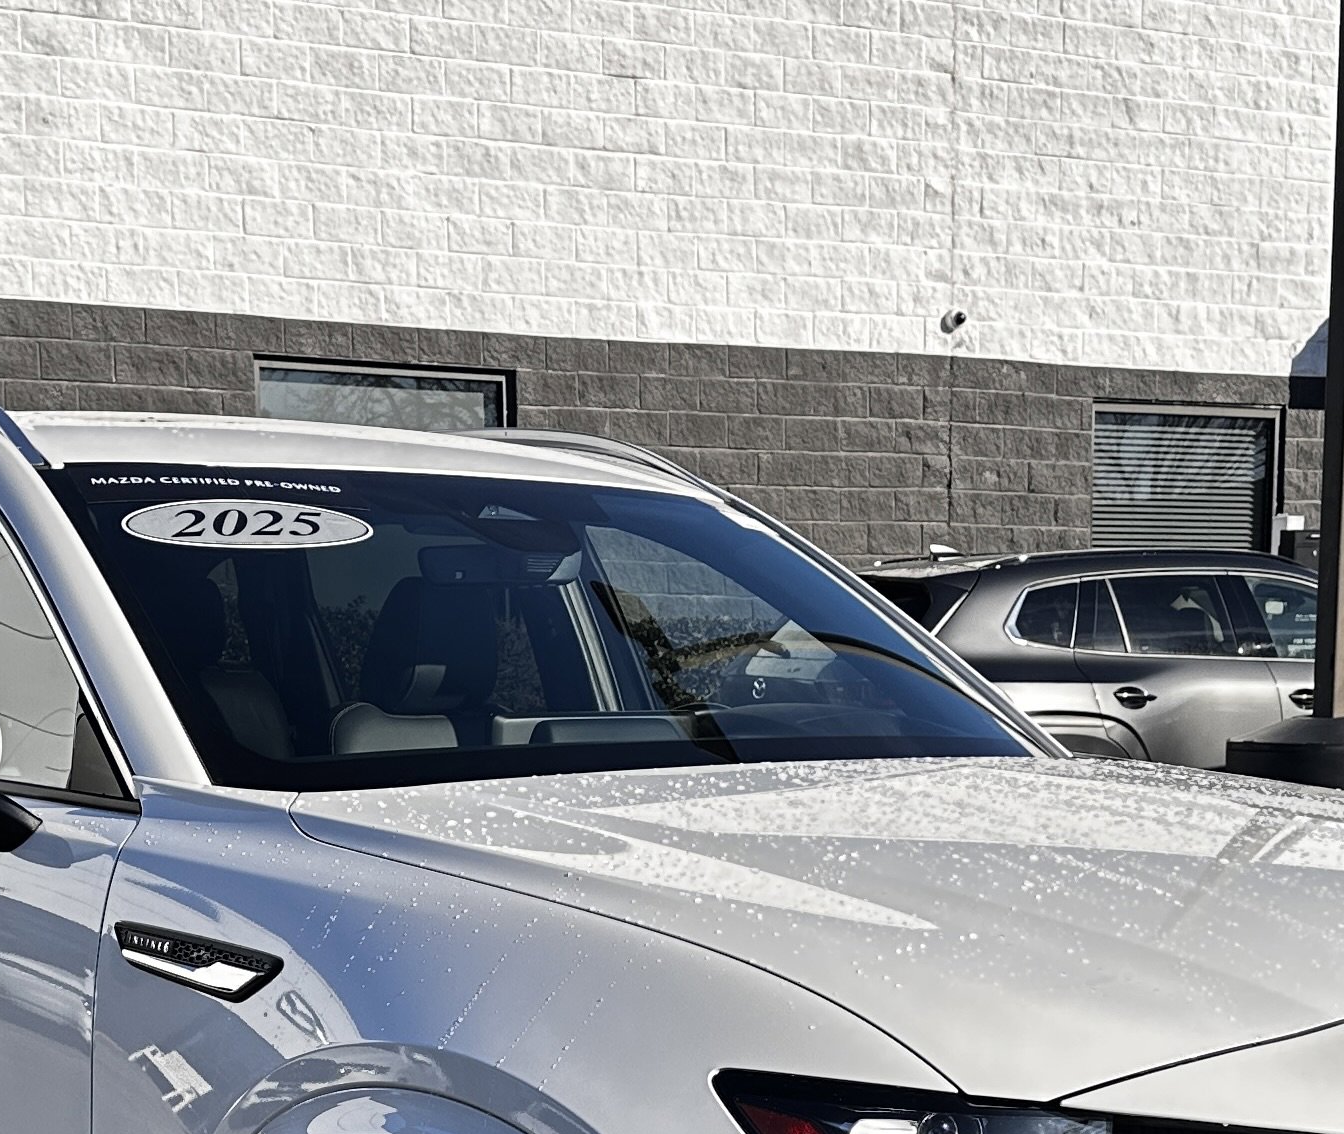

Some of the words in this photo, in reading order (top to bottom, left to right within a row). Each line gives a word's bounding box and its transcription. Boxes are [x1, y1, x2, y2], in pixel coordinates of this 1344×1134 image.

[90, 476, 156, 486] MAZDA
[160, 476, 240, 487] CERTIFIED
[244, 479, 342, 493] PRE-OWNED
[171, 509, 322, 538] 2025
